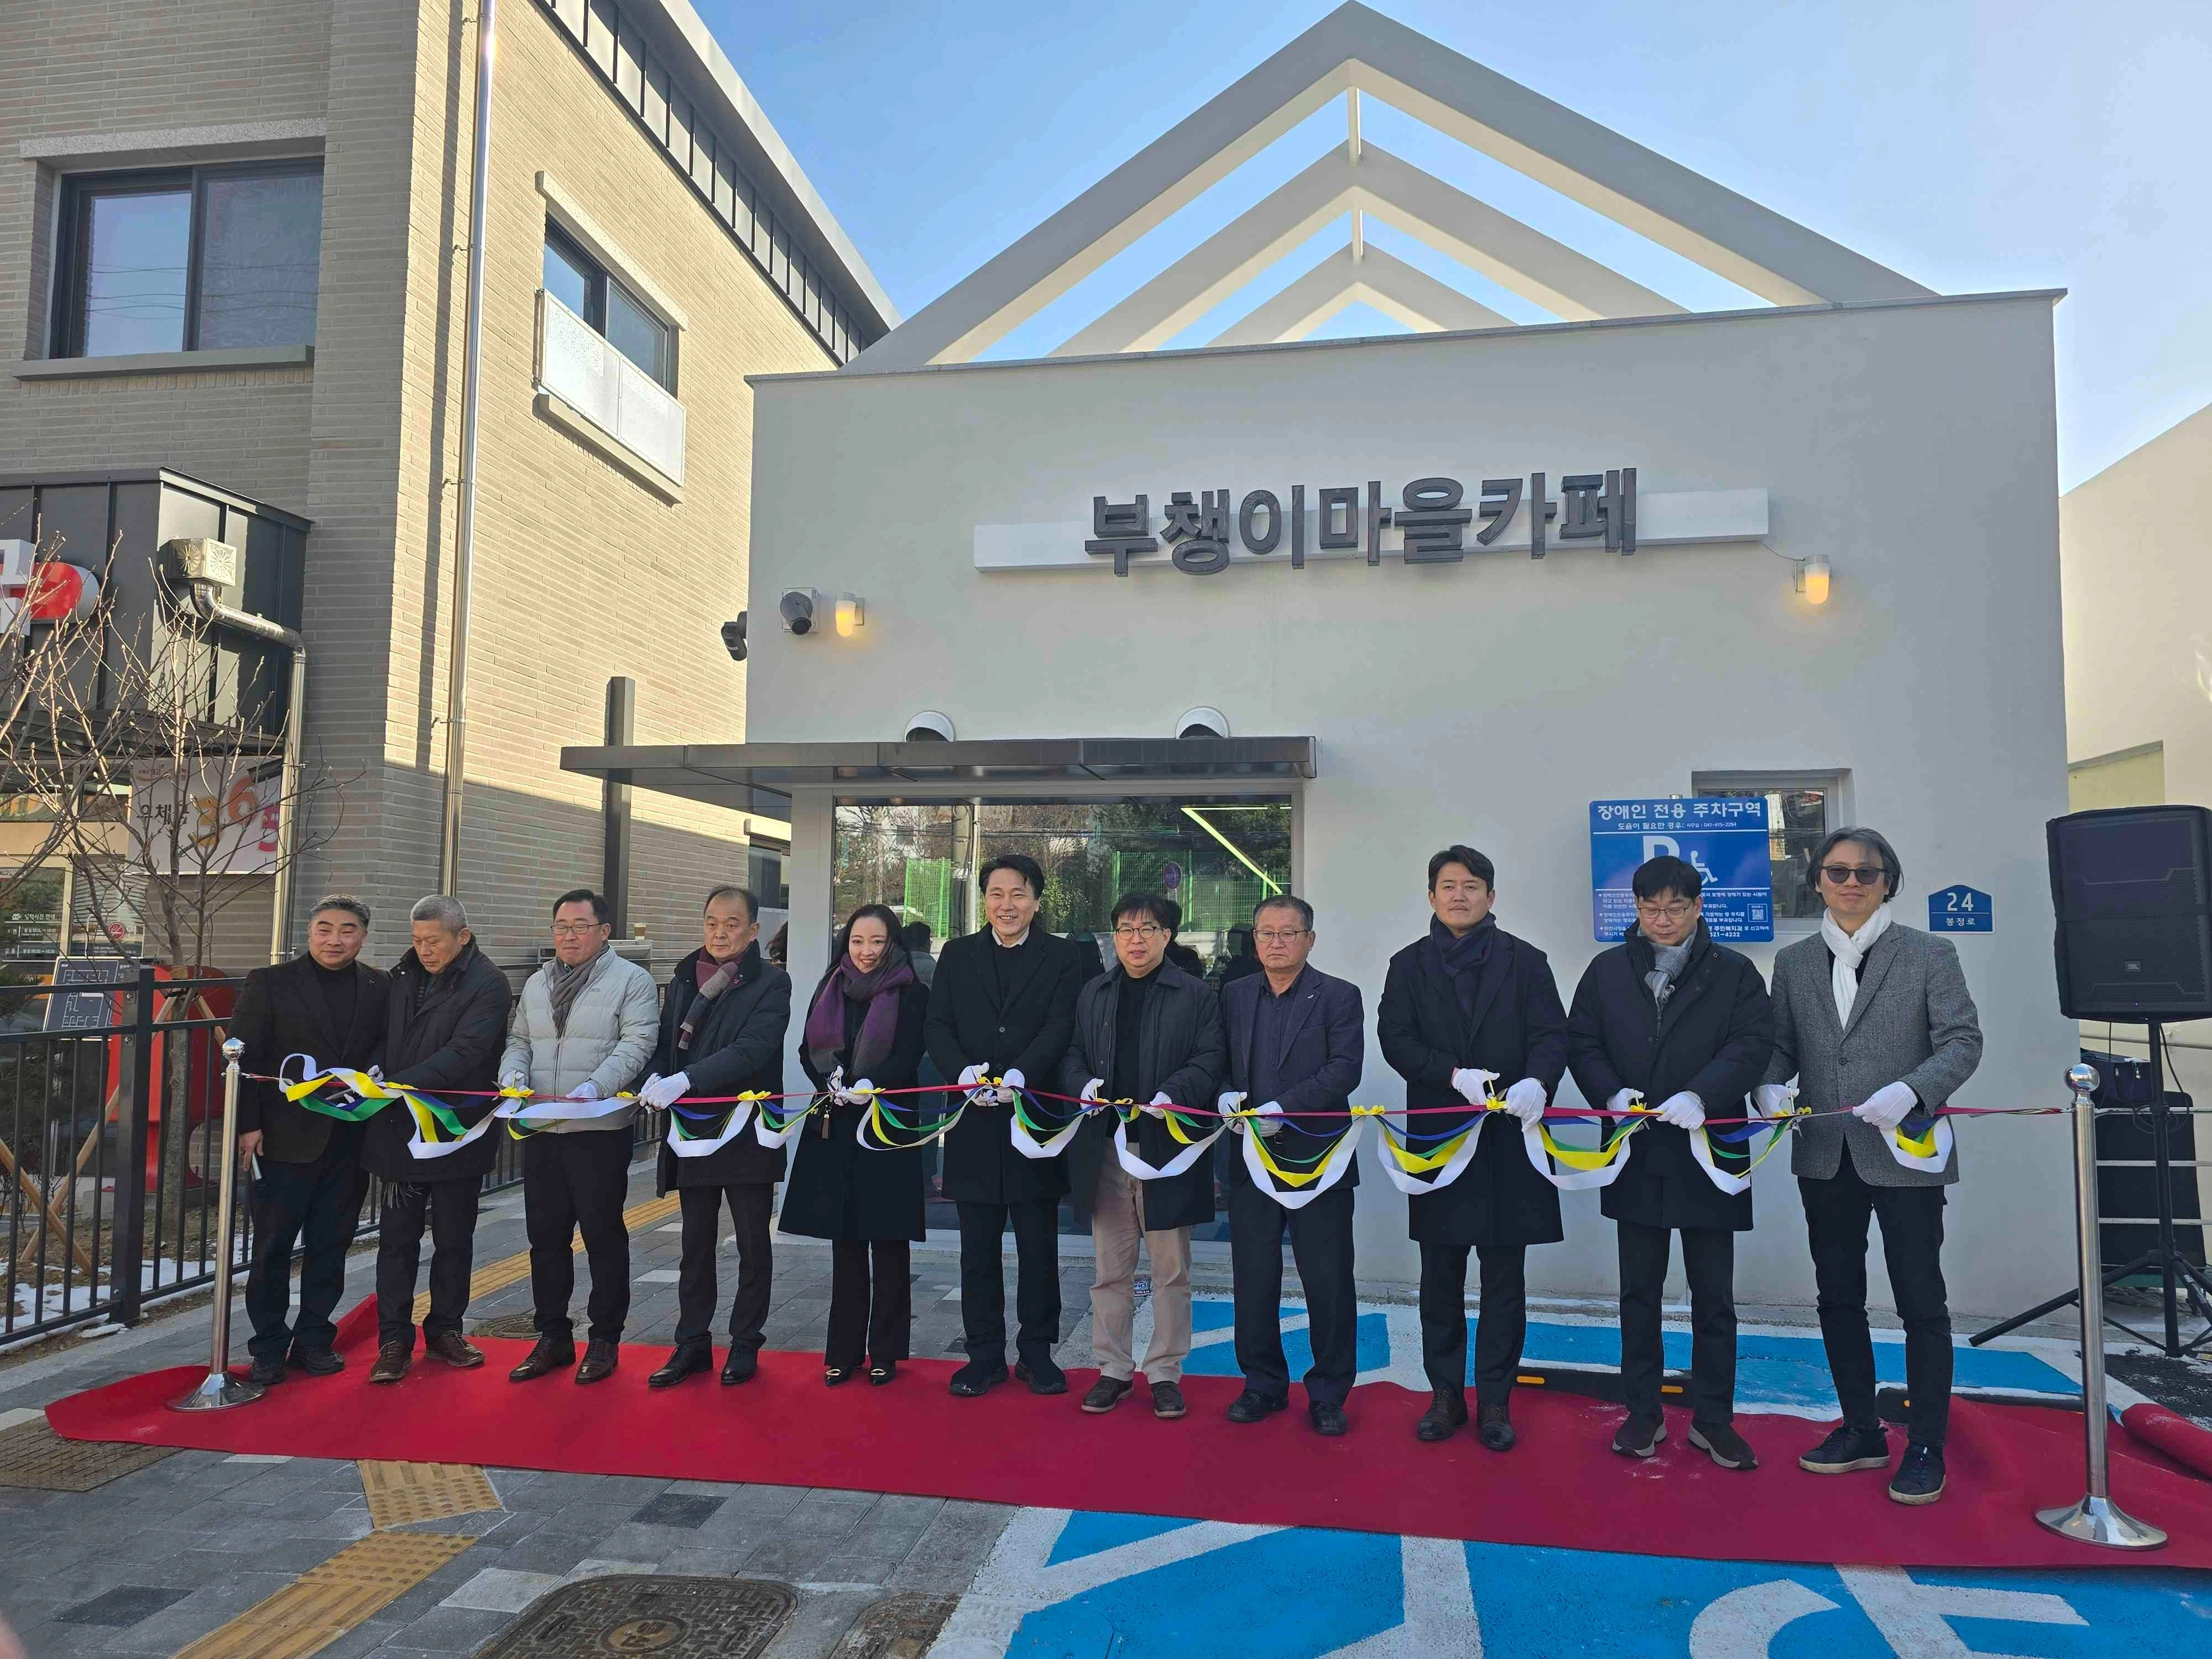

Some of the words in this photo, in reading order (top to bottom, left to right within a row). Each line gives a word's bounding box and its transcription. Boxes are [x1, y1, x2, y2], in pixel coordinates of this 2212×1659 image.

[1085, 468, 1637, 577] 부챙이마을카페
[1598, 805, 1646, 820] 장애인
[1654, 803, 1686, 818] 전용
[1693, 802, 1761, 817] 주차구역
[1947, 893, 1974, 911] 24
[1946, 917, 1976, 927] 봉정로
